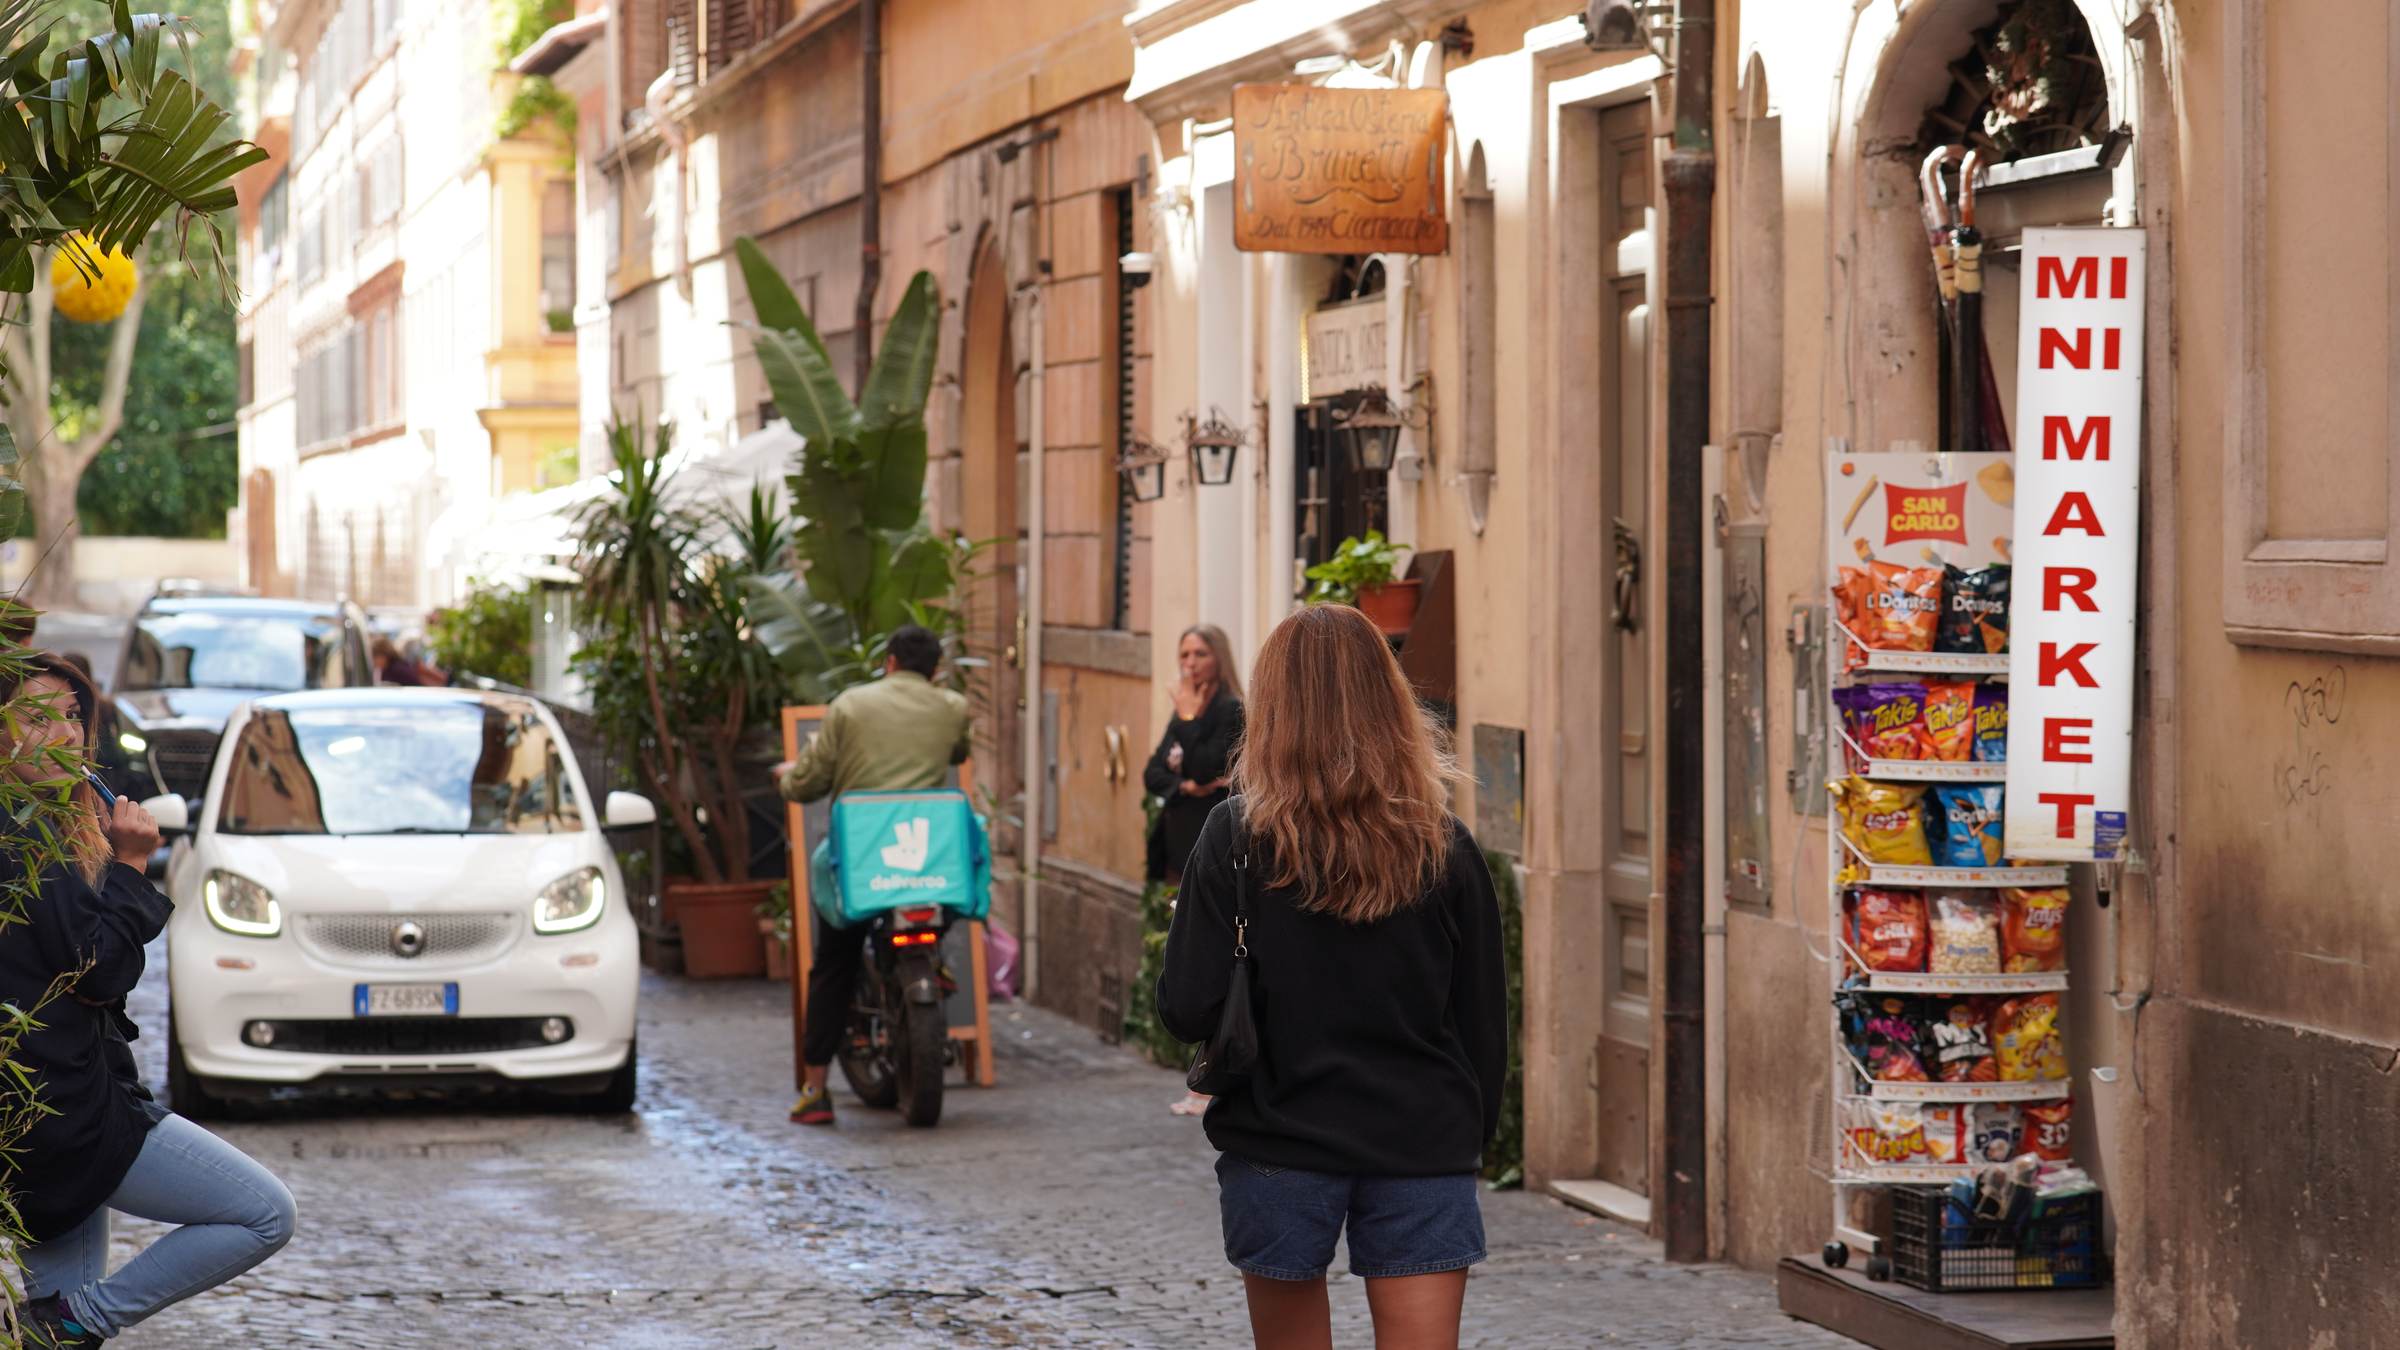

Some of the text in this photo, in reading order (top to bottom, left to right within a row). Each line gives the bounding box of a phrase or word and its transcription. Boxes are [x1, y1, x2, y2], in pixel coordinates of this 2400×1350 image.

[1259, 135, 1417, 183] Brunetti
[1902, 497, 1947, 513] SAN
[1890, 514, 1960, 531] CARLO
[1879, 592, 1937, 612] Doritos
[1951, 595, 2005, 613] Doritos
[1872, 696, 1918, 735] Takis
[1924, 698, 1968, 735] Takis
[869, 873, 947, 891] deliveroo
